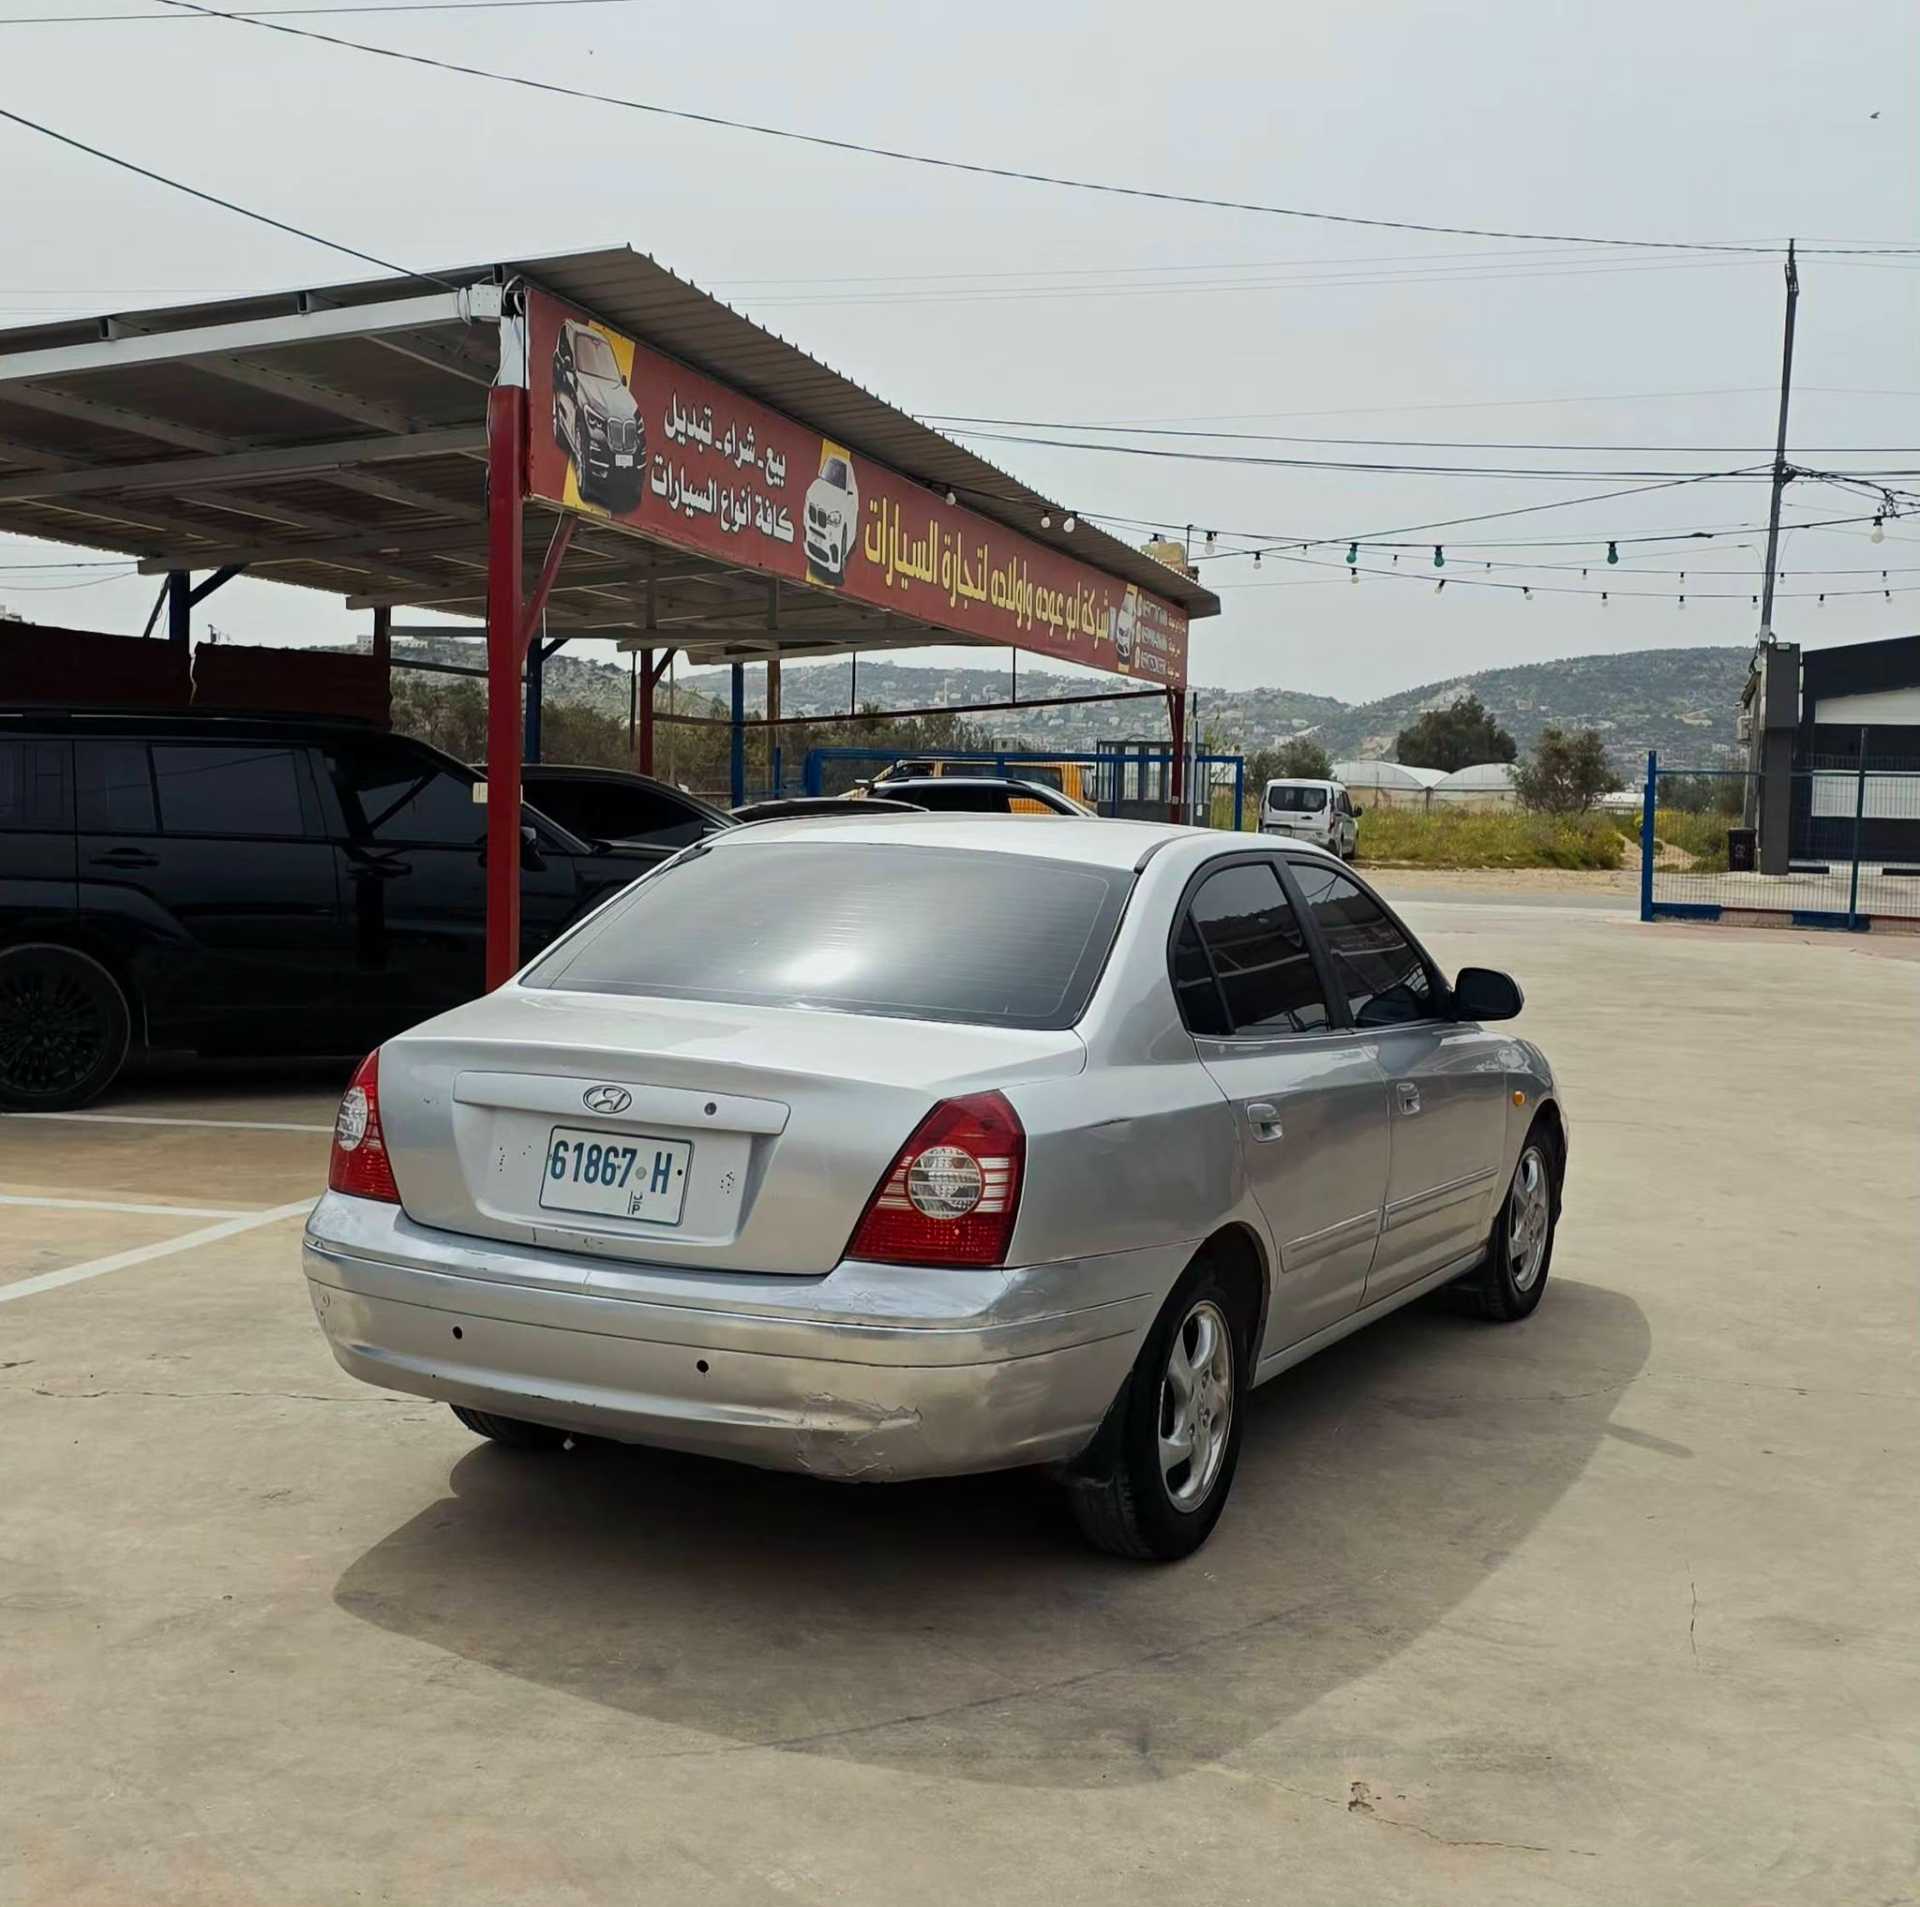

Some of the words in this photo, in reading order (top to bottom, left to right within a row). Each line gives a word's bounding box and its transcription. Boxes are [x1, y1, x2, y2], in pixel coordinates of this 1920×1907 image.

[663, 391, 713, 453] تبديل
[724, 421, 756, 469] شراء
[650, 454, 718, 518] السيارات
[765, 446, 786, 487] بيع
[755, 493, 795, 543] كافة
[864, 497, 938, 591] السيارات
[942, 532, 988, 609] لتجارة
[1081, 588, 1109, 650] شركة
[550, 1140, 638, 1188] 61867
[650, 1151, 673, 1195] H
